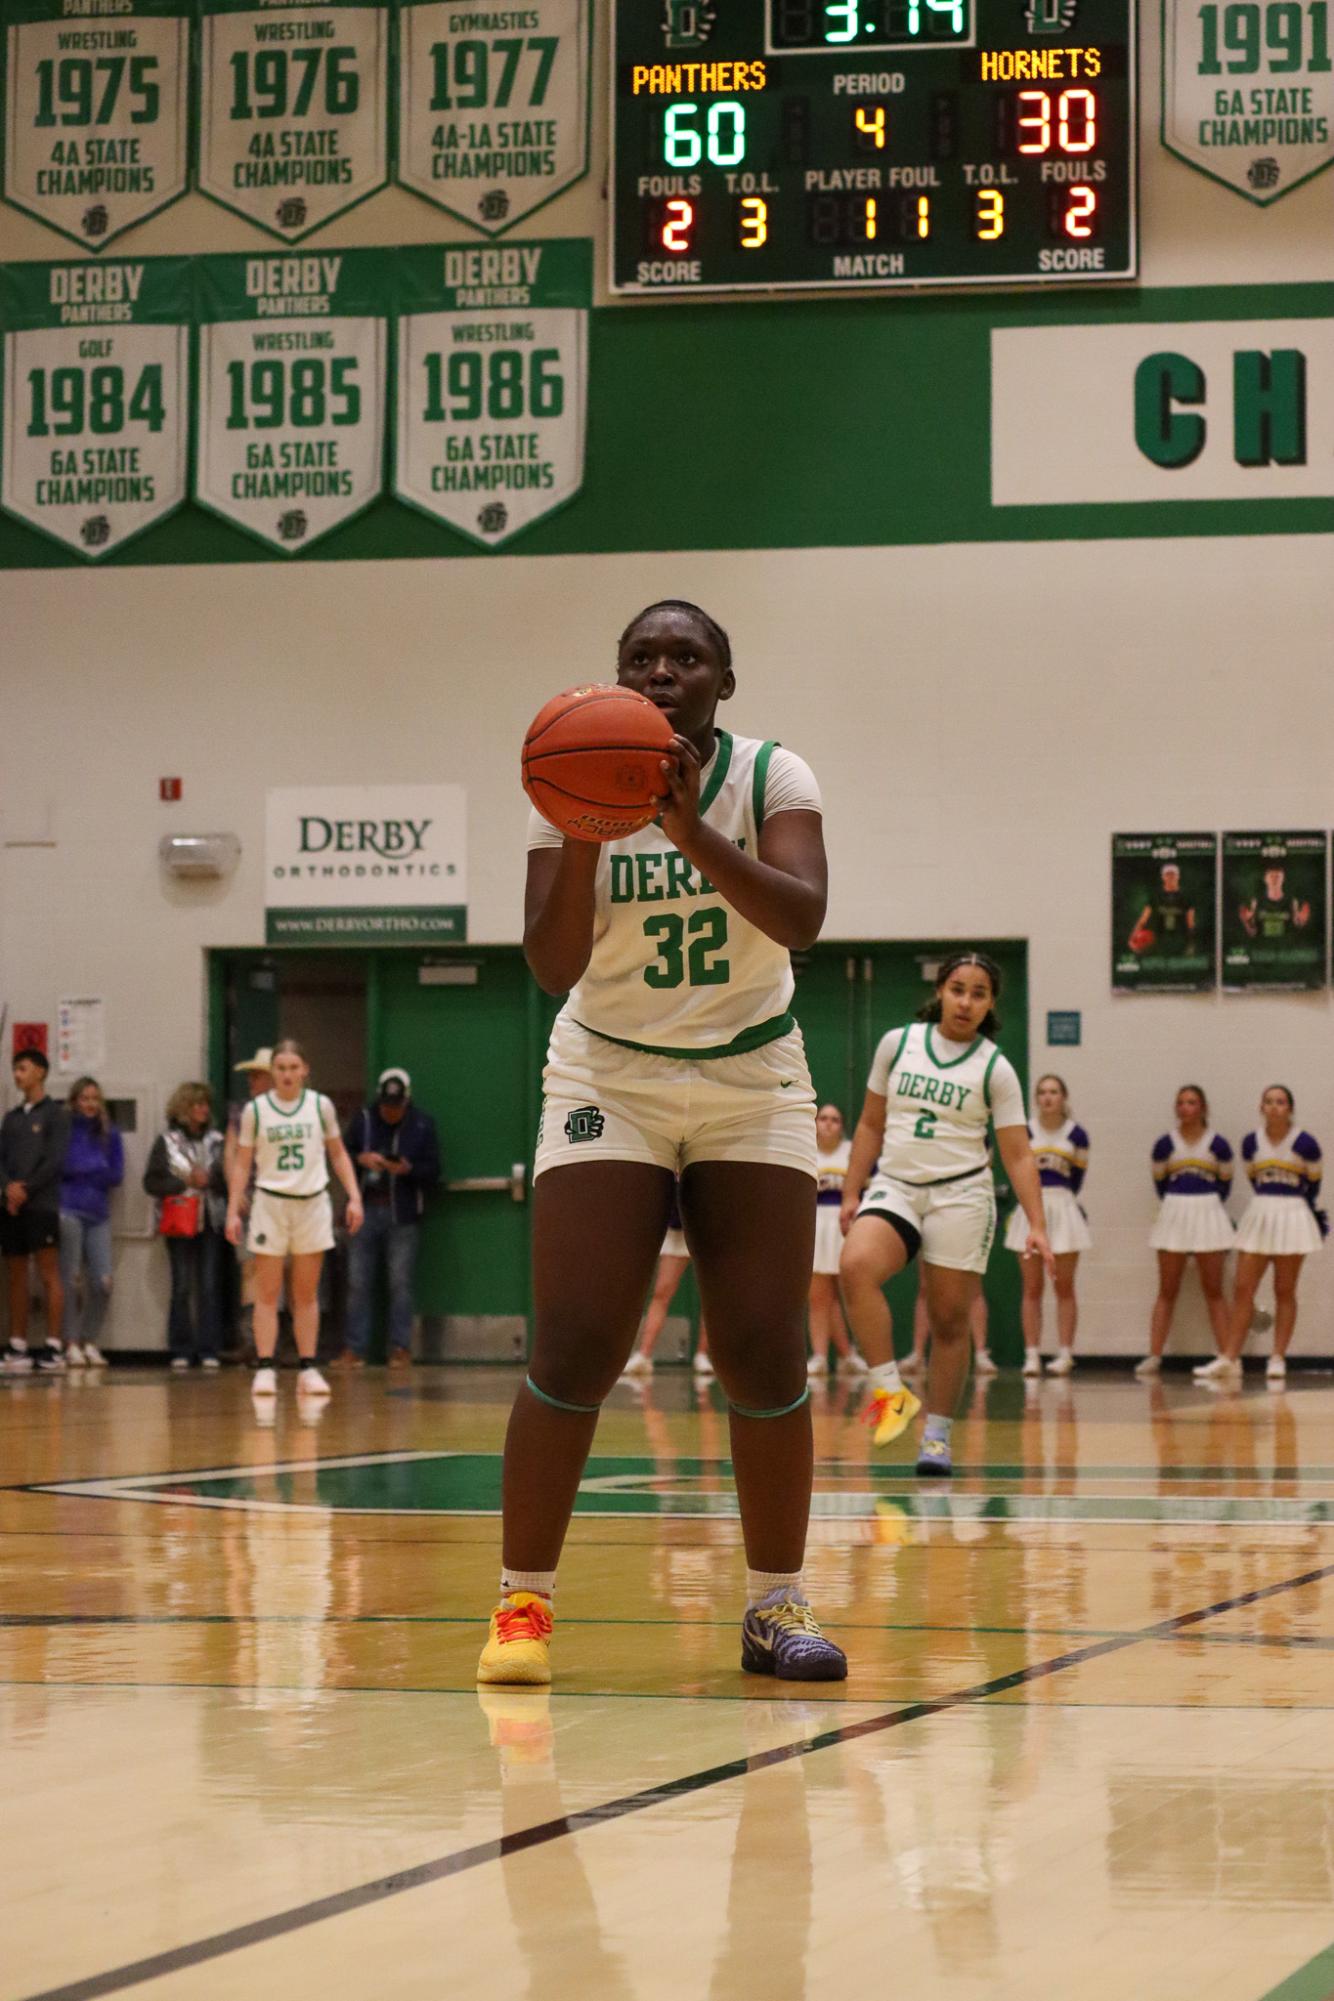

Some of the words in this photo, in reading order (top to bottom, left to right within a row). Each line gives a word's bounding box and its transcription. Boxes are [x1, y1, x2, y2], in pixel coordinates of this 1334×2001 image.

[255, 21, 335, 42] WRESTLING
[449, 11, 539, 33] GYMNASTICS
[58, 30, 137, 50] WRESTLING
[1197, 1, 1332, 75] 1991
[429, 36, 559, 111] 1977
[632, 60, 766, 95] PANTHERS
[981, 47, 1101, 82] HORNETS
[34, 56, 160, 127] 1975
[229, 46, 359, 120] 1976
[832, 73, 905, 96] PERIOD
[1215, 90, 1244, 116] 6A
[1251, 87, 1313, 115] STATE
[431, 123, 492, 150] 4A-1A
[498, 120, 557, 147] STATE
[664, 101, 746, 167] 60
[855, 106, 886, 149] 4
[1018, 89, 1096, 154] 30
[1199, 117, 1328, 147] CHAMPIONS
[51, 141, 80, 166] 4A
[85, 138, 140, 165] STATE
[248, 133, 277, 157] 4A
[280, 129, 339, 156] STATE
[233, 158, 353, 188] CHAMPIONS
[432, 150, 556, 180] CHAMPIONS
[805, 170, 881, 191] PLAYER
[889, 166, 940, 188] FOUL
[963, 164, 1018, 186] T.O.L.
[1041, 160, 1106, 182] FOULS
[36, 167, 154, 195] CHAMPIONS
[637, 175, 702, 197] FOULS
[725, 172, 779, 194] T.O.L.
[661, 199, 694, 251] 2
[740, 197, 768, 248] 3
[977, 189, 1004, 241] 3
[1065, 186, 1097, 238] 2
[444, 248, 542, 288] DERBY
[637, 261, 702, 283] SCORE
[832, 254, 904, 277] MATCH
[1038, 248, 1105, 271] SCORE
[50, 264, 144, 305] DERBY
[246, 257, 342, 296] DERBY
[257, 295, 331, 317] PANTHERS
[456, 286, 531, 307] PANTHERS
[60, 303, 133, 323] PANTHERS
[252, 331, 335, 352] WRESTLING
[452, 322, 535, 344] WRESTLING
[79, 339, 114, 358] GOLF
[27, 363, 166, 437] 1984
[226, 356, 361, 430] 1985
[423, 348, 564, 422] 1986
[51, 450, 78, 476] 6A
[83, 447, 140, 473] STATE
[247, 443, 275, 469] 6A
[279, 441, 338, 467] STATE
[446, 436, 474, 462] 6A
[480, 433, 539, 461] STATE
[36, 476, 155, 506] CHAMPIONS
[231, 470, 353, 500] CHAMPIONS
[431, 462, 555, 492] CHAMPIONS
[298, 816, 433, 859] DERBY
[273, 863, 457, 878] ORTHODONTICS
[643, 907, 730, 989] 32
[896, 1071, 972, 1112] DERBY
[267, 1123, 313, 1143] DERBY
[913, 1107, 938, 1139] 2
[277, 1144, 305, 1170] 25
